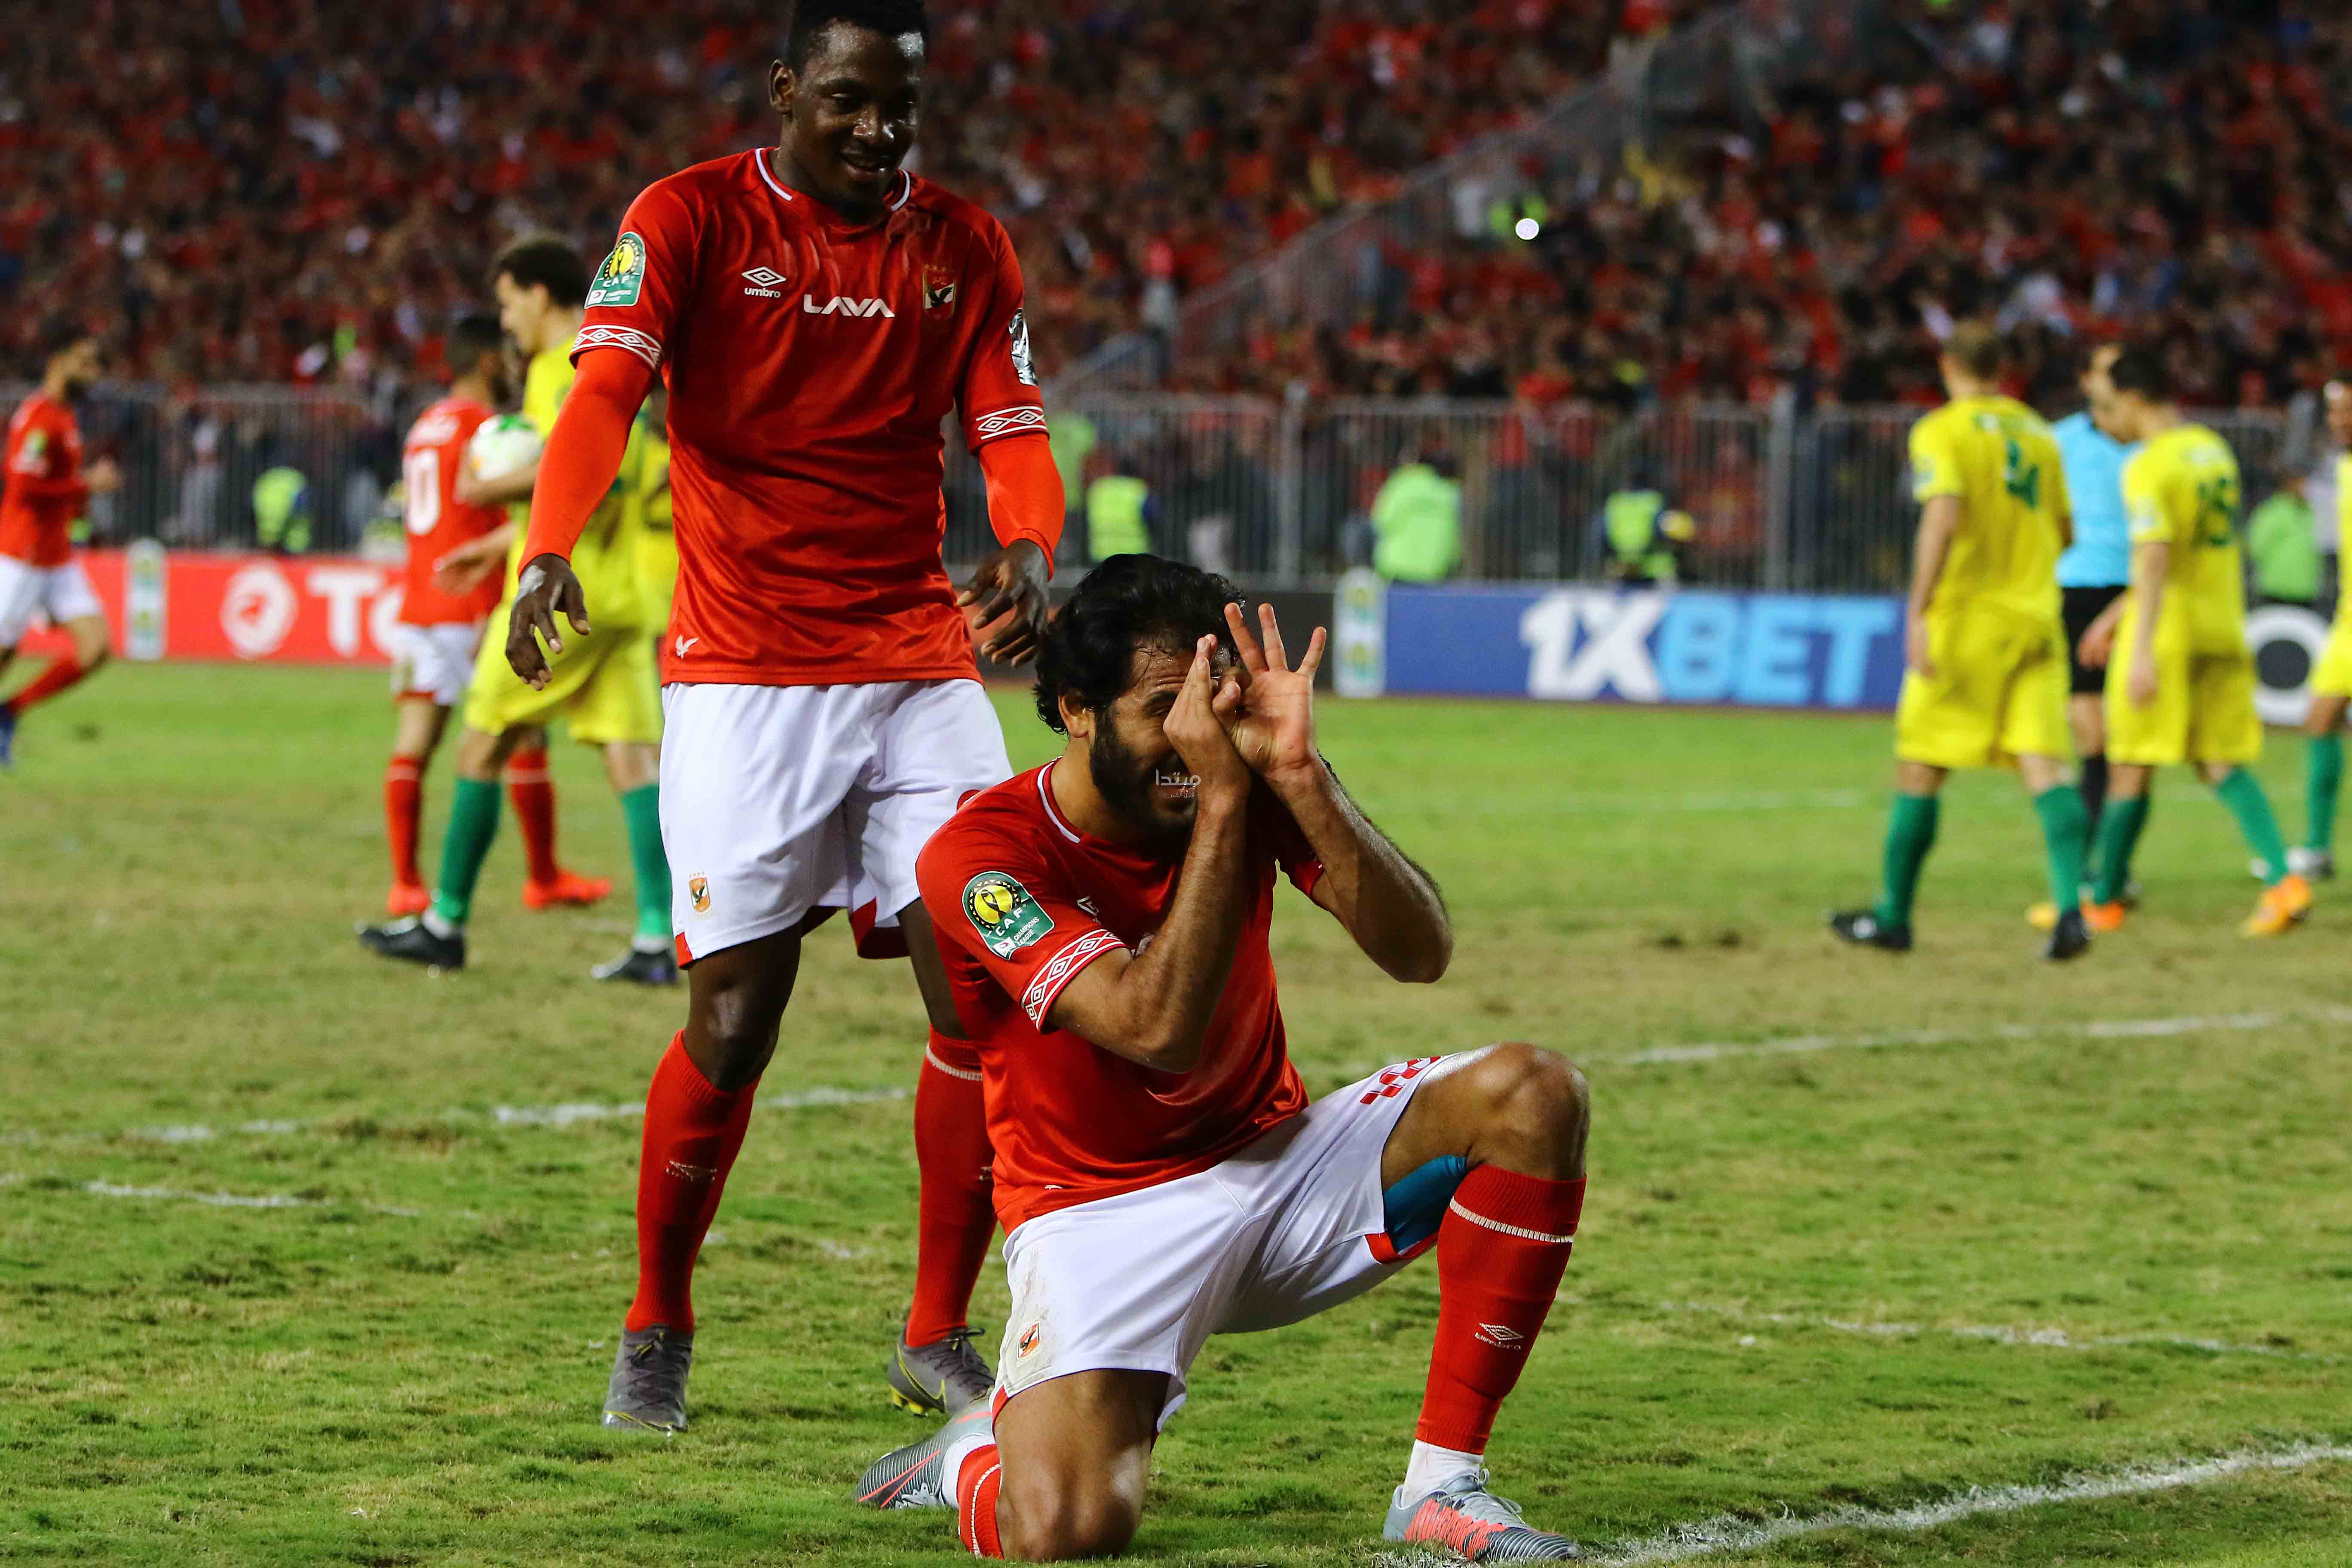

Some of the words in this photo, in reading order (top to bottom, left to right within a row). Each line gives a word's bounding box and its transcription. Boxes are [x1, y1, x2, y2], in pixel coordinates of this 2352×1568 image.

[602, 275, 630, 288] CAF
[744, 287, 781, 298] umbro
[803, 294, 895, 318] LAVA
[1519, 589, 1897, 707] 1XBET
[995, 907, 1023, 936] CAF
[1013, 916, 1040, 941] CHAMPIONS
[1017, 929, 1035, 946] LEAGUE
